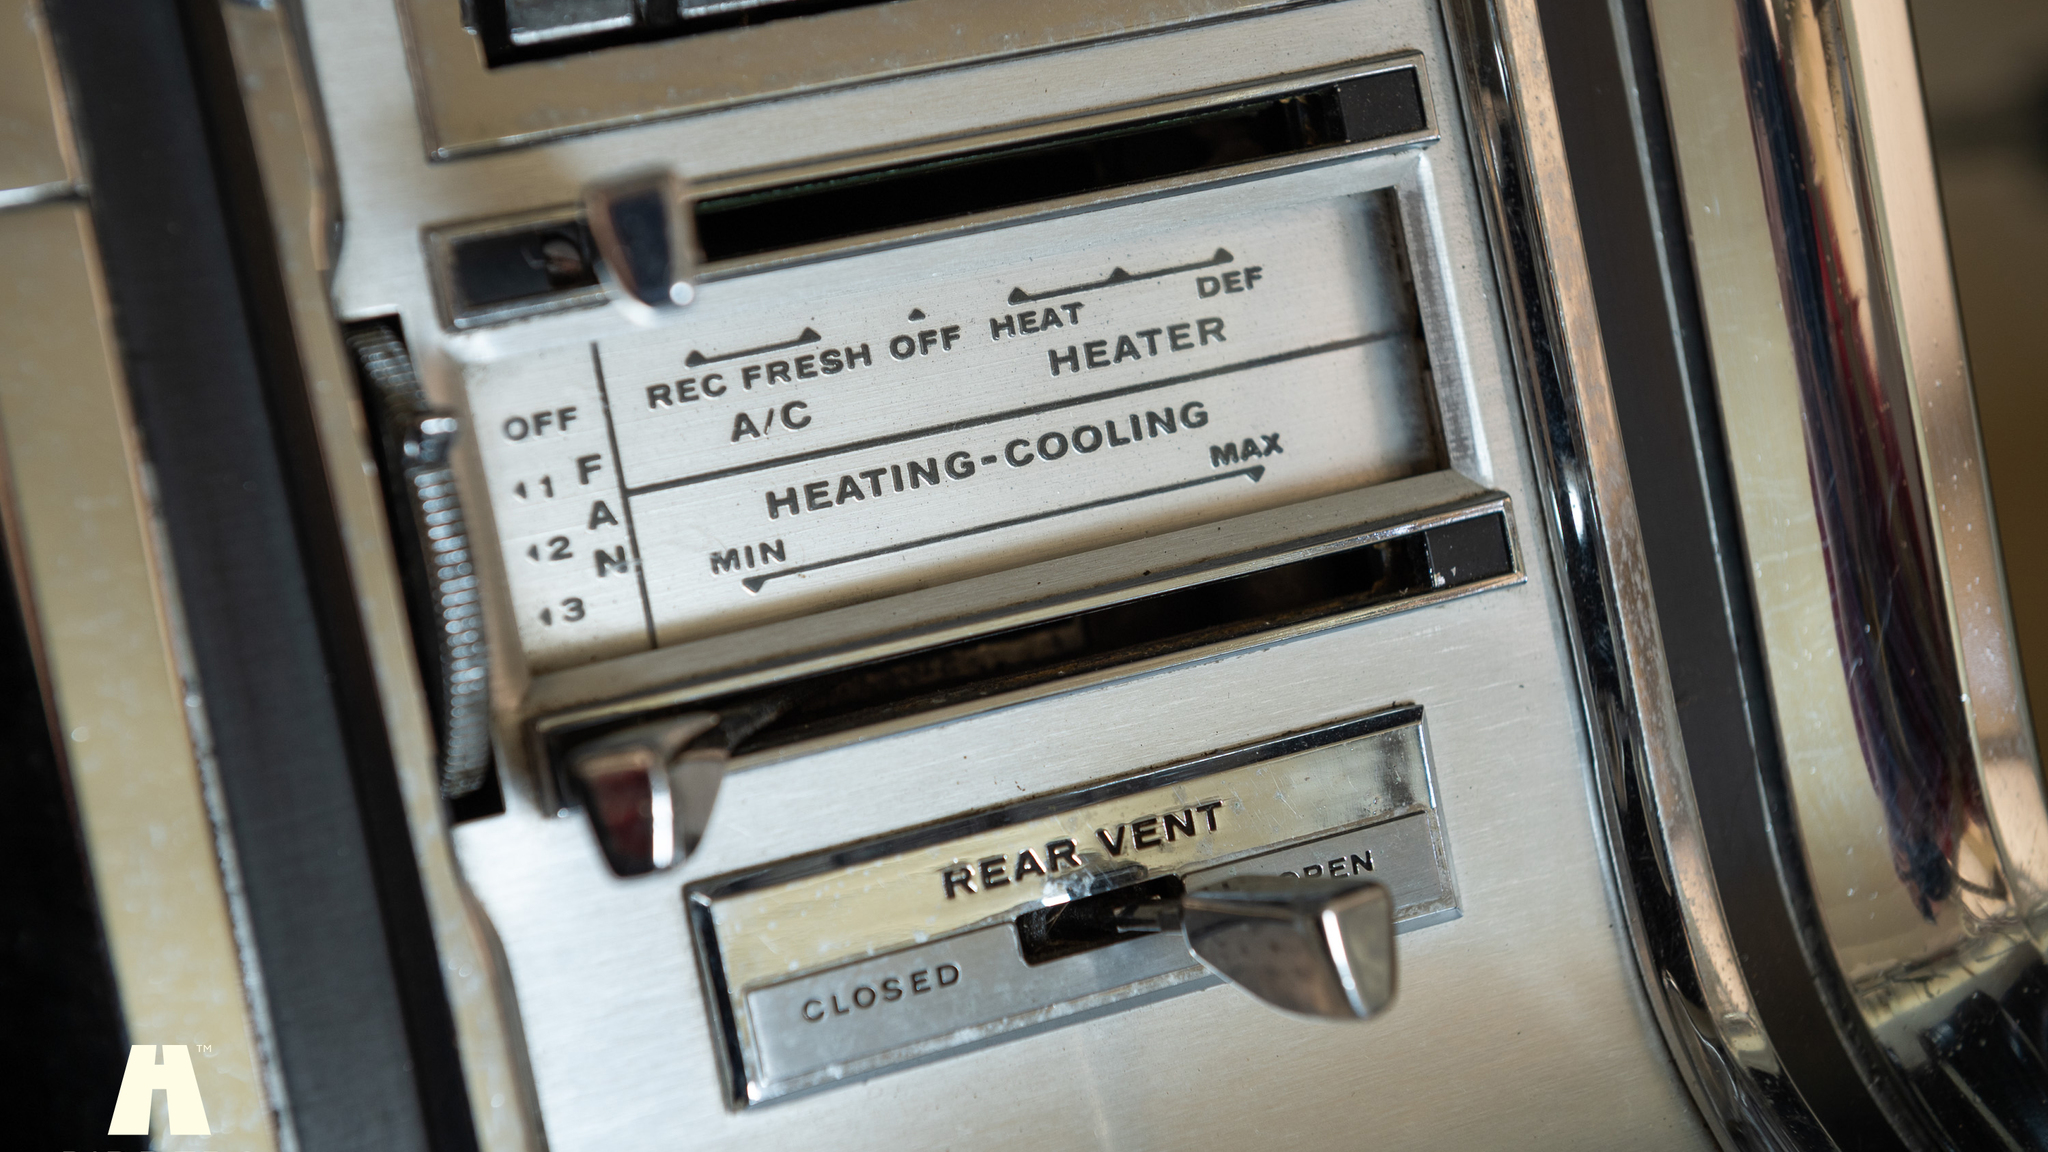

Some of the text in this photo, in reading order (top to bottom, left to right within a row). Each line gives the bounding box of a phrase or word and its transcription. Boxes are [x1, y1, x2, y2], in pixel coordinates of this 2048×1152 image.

[1195, 265, 1264, 300] DEF
[989, 302, 1086, 341] HEAT
[1048, 316, 1227, 377] HEATER
[645, 325, 961, 410] REC FRESH OFF
[502, 406, 578, 441] OFF
[730, 400, 812, 443] A/C
[765, 400, 1209, 520] HEATING-COOLING
[1209, 432, 1284, 468] MAX
[539, 474, 555, 499] 1
[547, 536, 575, 562] 2
[709, 538, 787, 575] MIN
[560, 597, 587, 623] 3
[942, 800, 1225, 900] REAR VENT
[1280, 849, 1375, 879] PEN
[801, 962, 961, 1022] CLOSED
